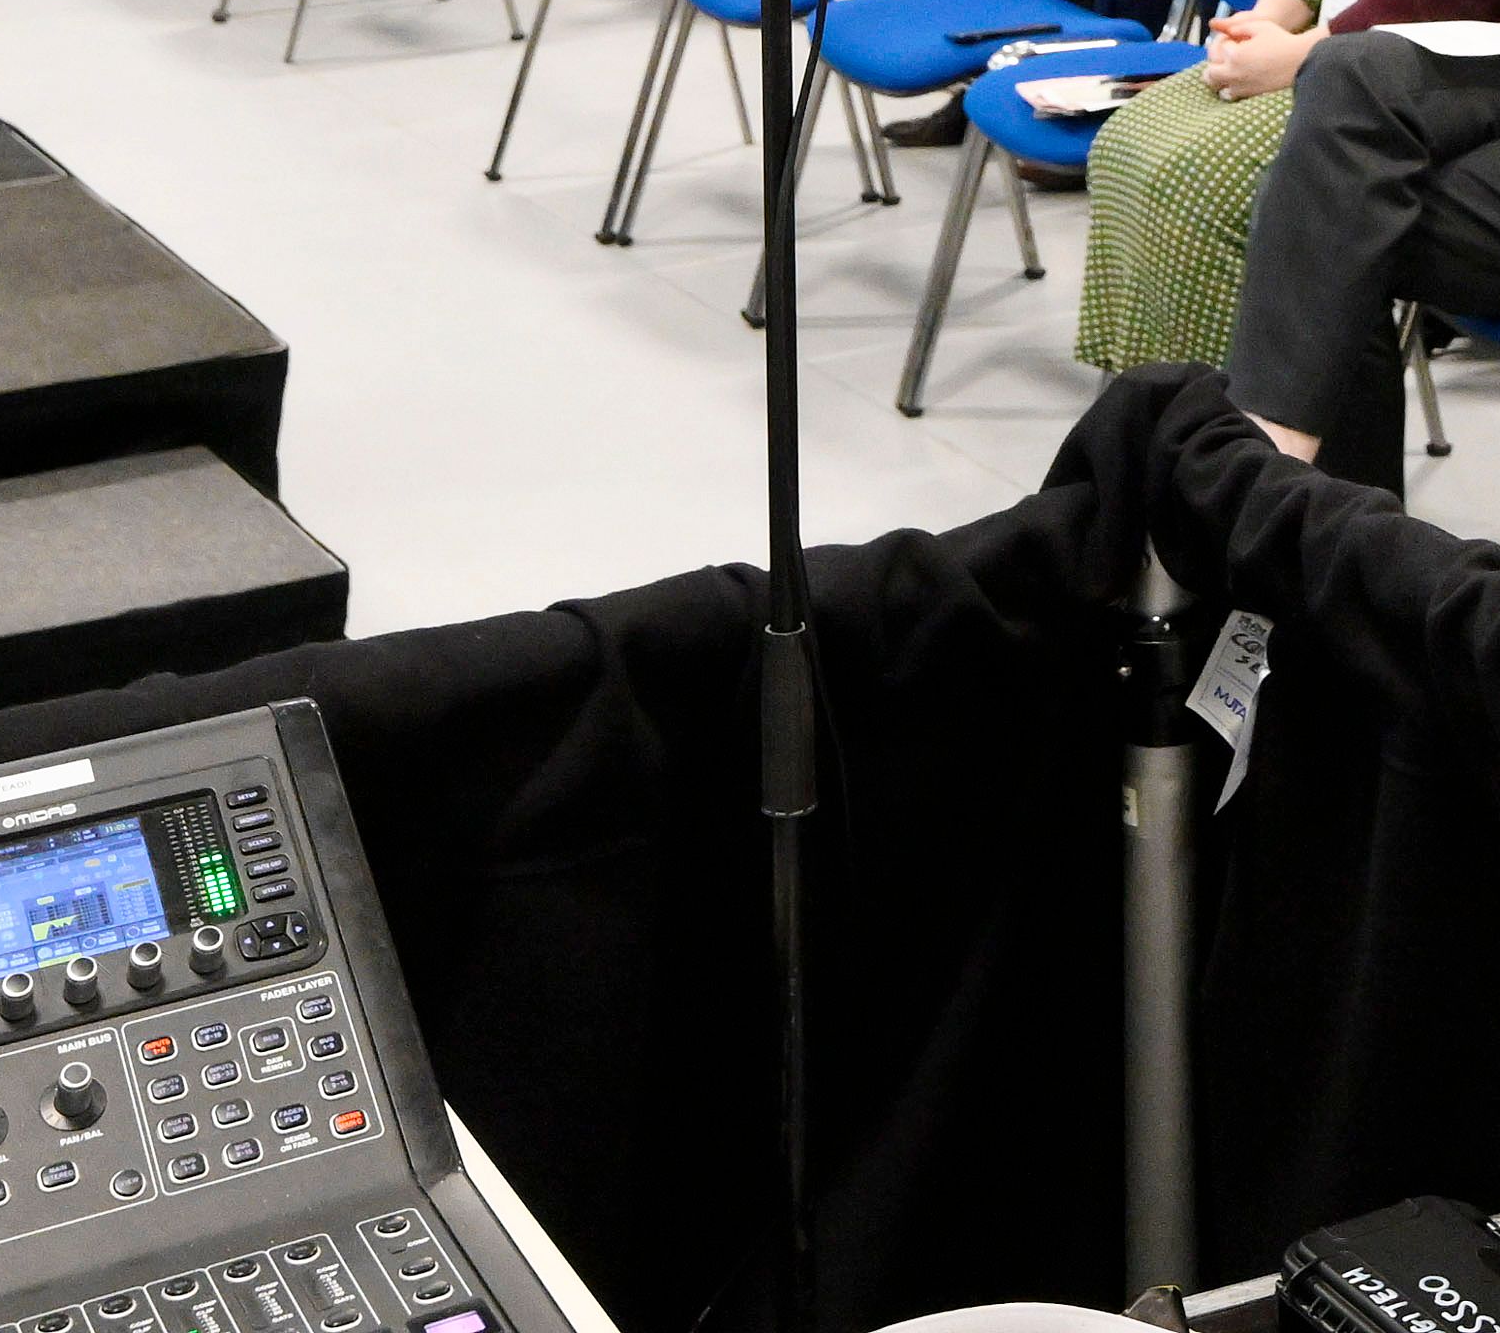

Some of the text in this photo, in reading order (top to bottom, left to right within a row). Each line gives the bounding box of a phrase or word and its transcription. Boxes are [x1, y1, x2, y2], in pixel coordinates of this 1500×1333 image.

[14, 803, 78, 828] MIDAS
[261, 977, 332, 1002] FADER LAYER
[58, 1033, 112, 1054] MAIN BUS
[59, 1128, 104, 1147] PAN/BAL
[293, 1137, 318, 1150] FADER
